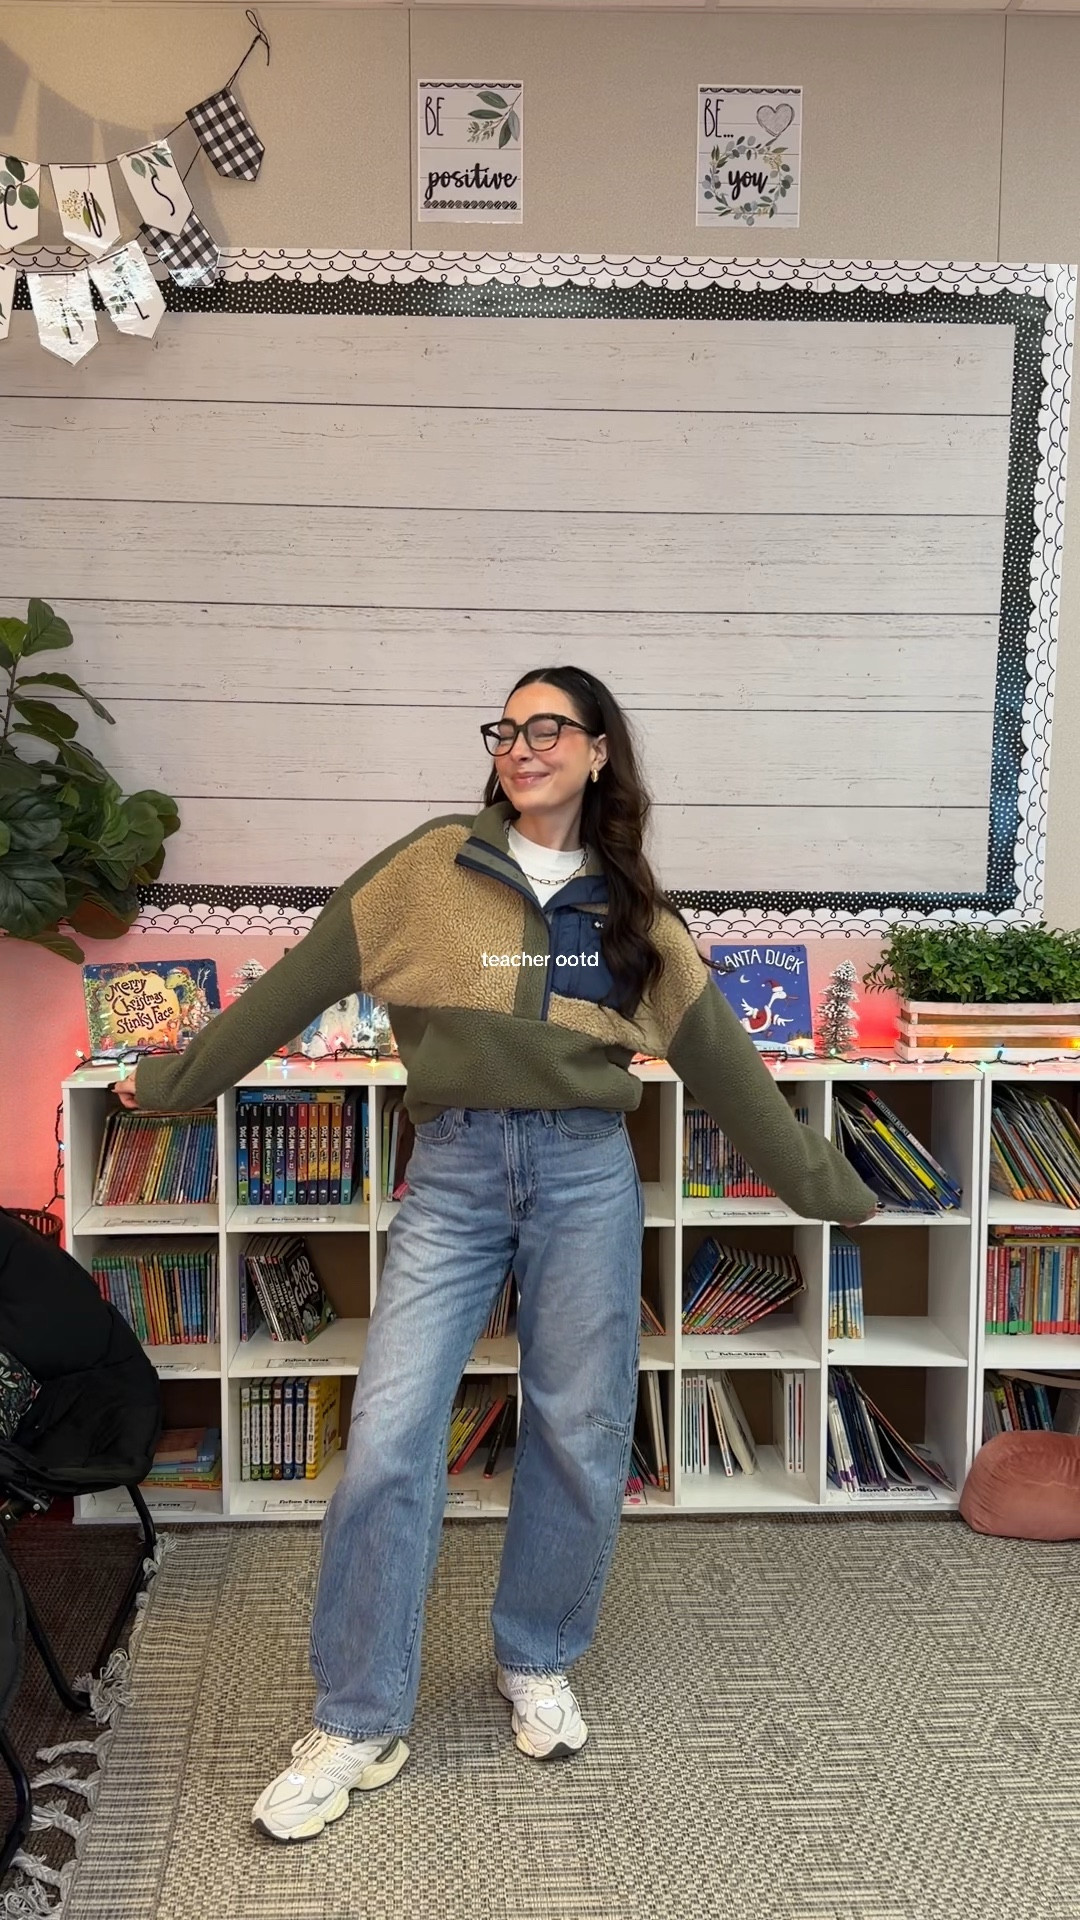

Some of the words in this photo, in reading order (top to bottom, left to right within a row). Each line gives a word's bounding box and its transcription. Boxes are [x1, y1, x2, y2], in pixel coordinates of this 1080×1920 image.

[425, 96, 445, 136] BE
[424, 163, 518, 200] positive
[728, 170, 768, 201] you
[765, 949, 805, 975] DUCK
[105, 978, 147, 1001] Merry
[117, 1012, 154, 1034] Stinky
[152, 1004, 174, 1024] Face
[291, 1255, 310, 1285] BAD
[294, 1271, 319, 1307] GUYS
